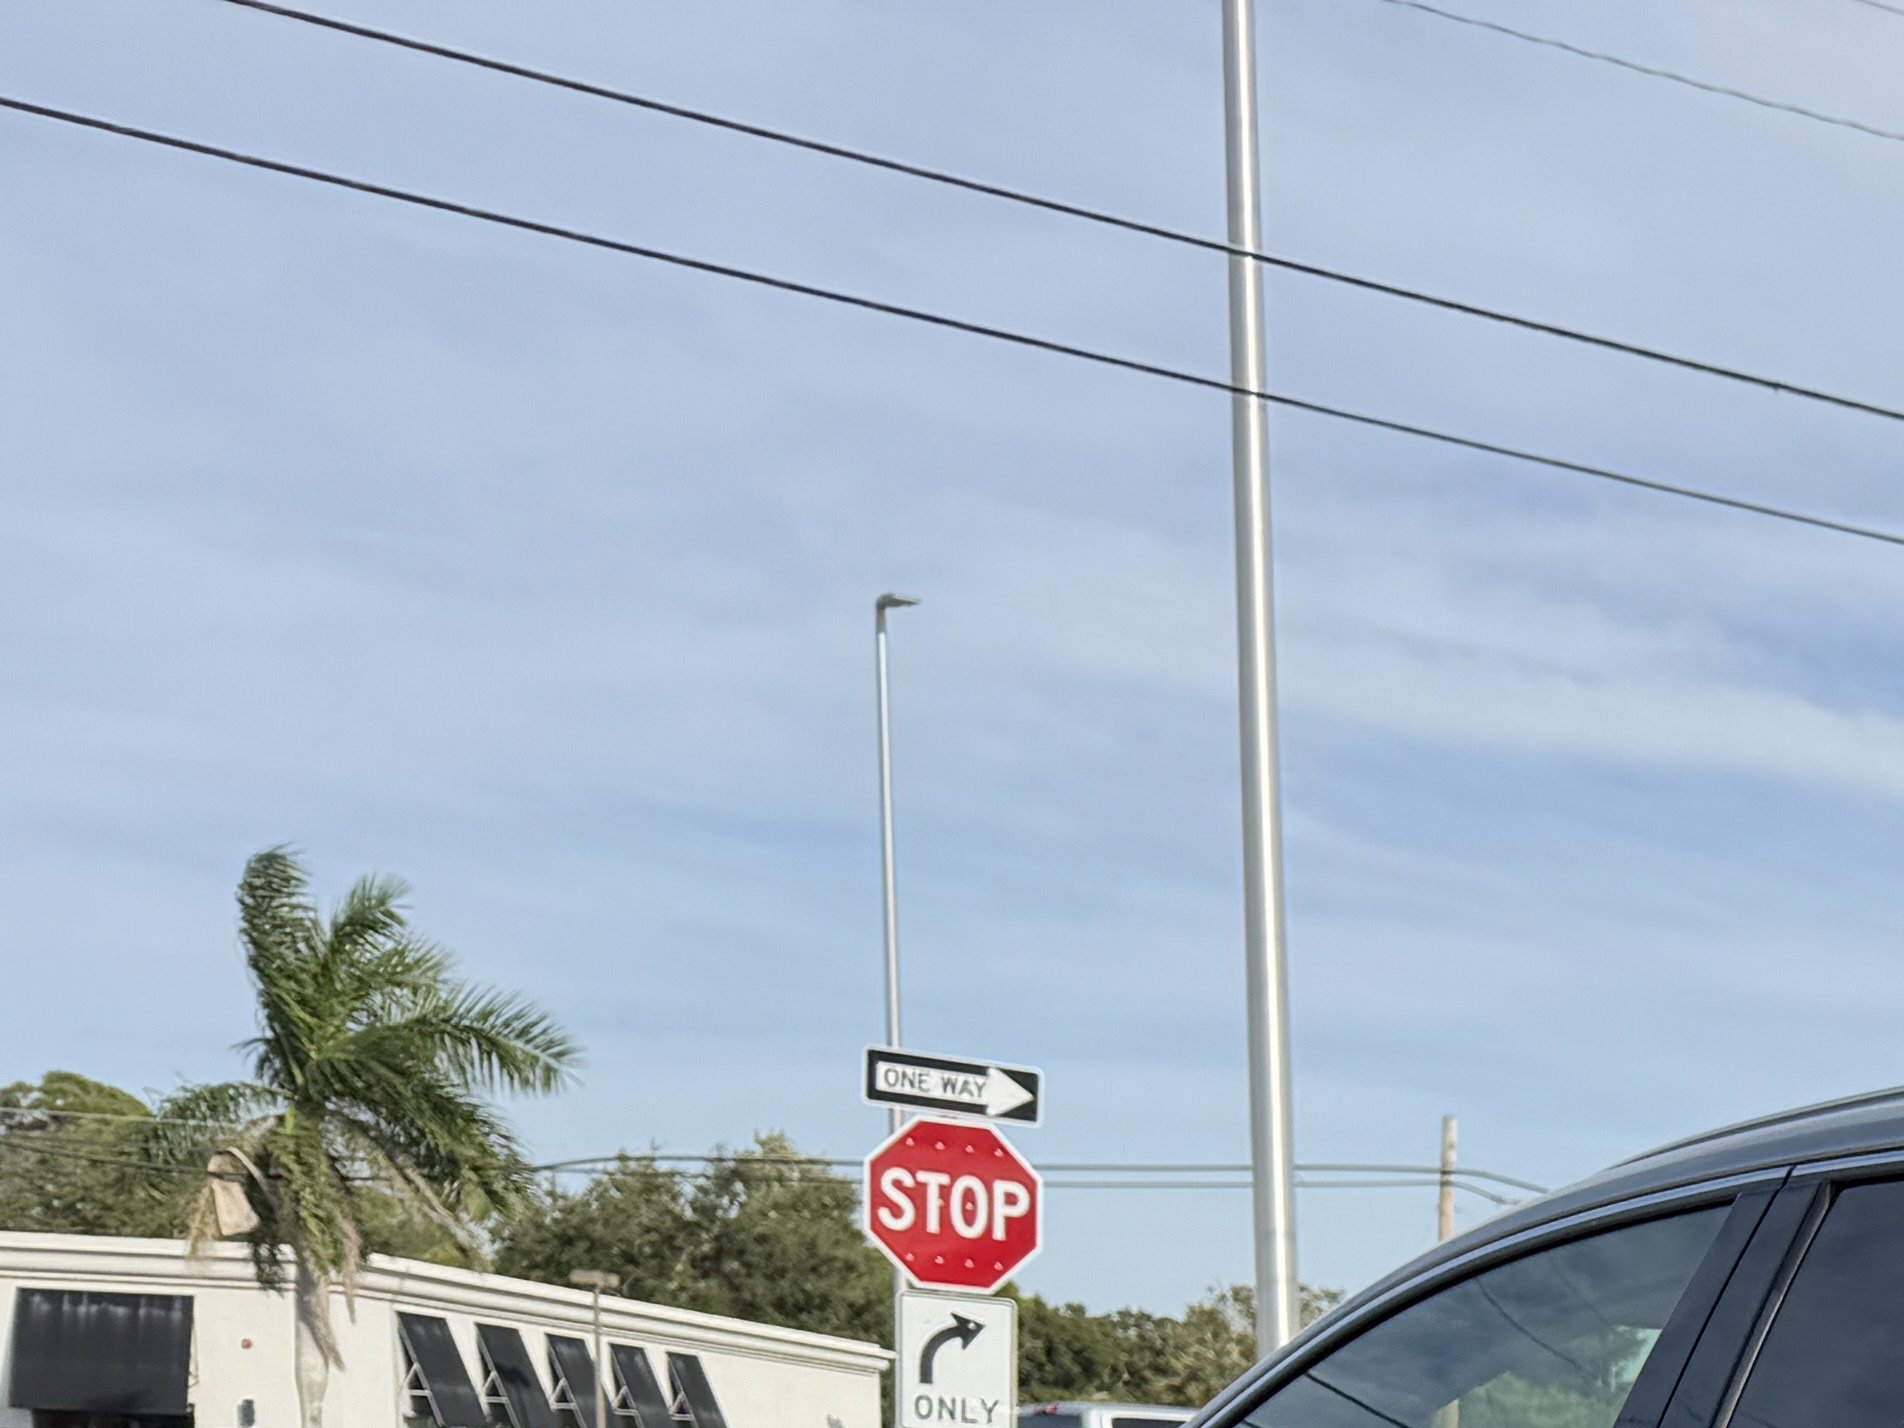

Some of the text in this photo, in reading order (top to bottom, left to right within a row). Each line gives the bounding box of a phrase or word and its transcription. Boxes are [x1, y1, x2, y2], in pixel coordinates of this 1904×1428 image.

[883, 1067, 987, 1099] ONE WAY
[876, 1167, 1031, 1241] STOP
[914, 1394, 1000, 1425] ONLY
